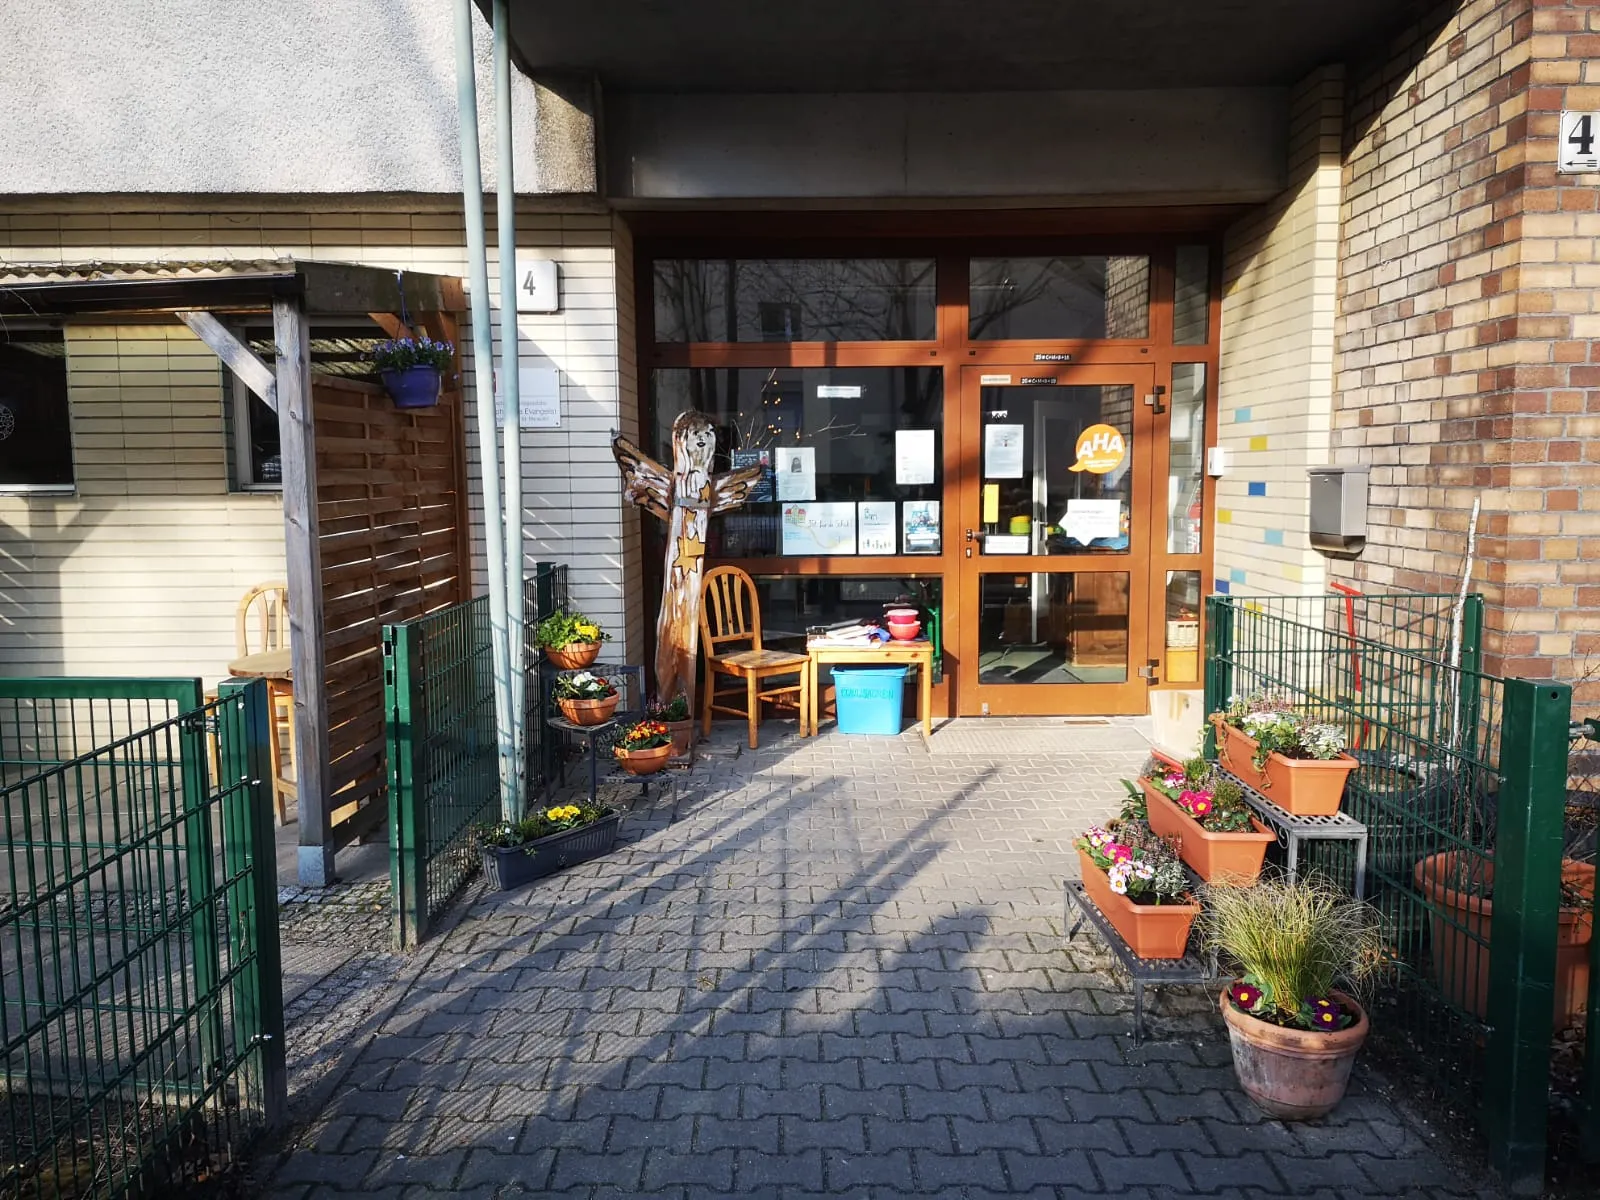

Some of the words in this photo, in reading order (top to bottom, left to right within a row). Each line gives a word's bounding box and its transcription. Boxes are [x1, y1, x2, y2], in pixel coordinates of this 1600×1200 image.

[1568, 115, 1594, 154] 4
[523, 271, 536, 295] 4
[1077, 432, 1123, 459] AHA
